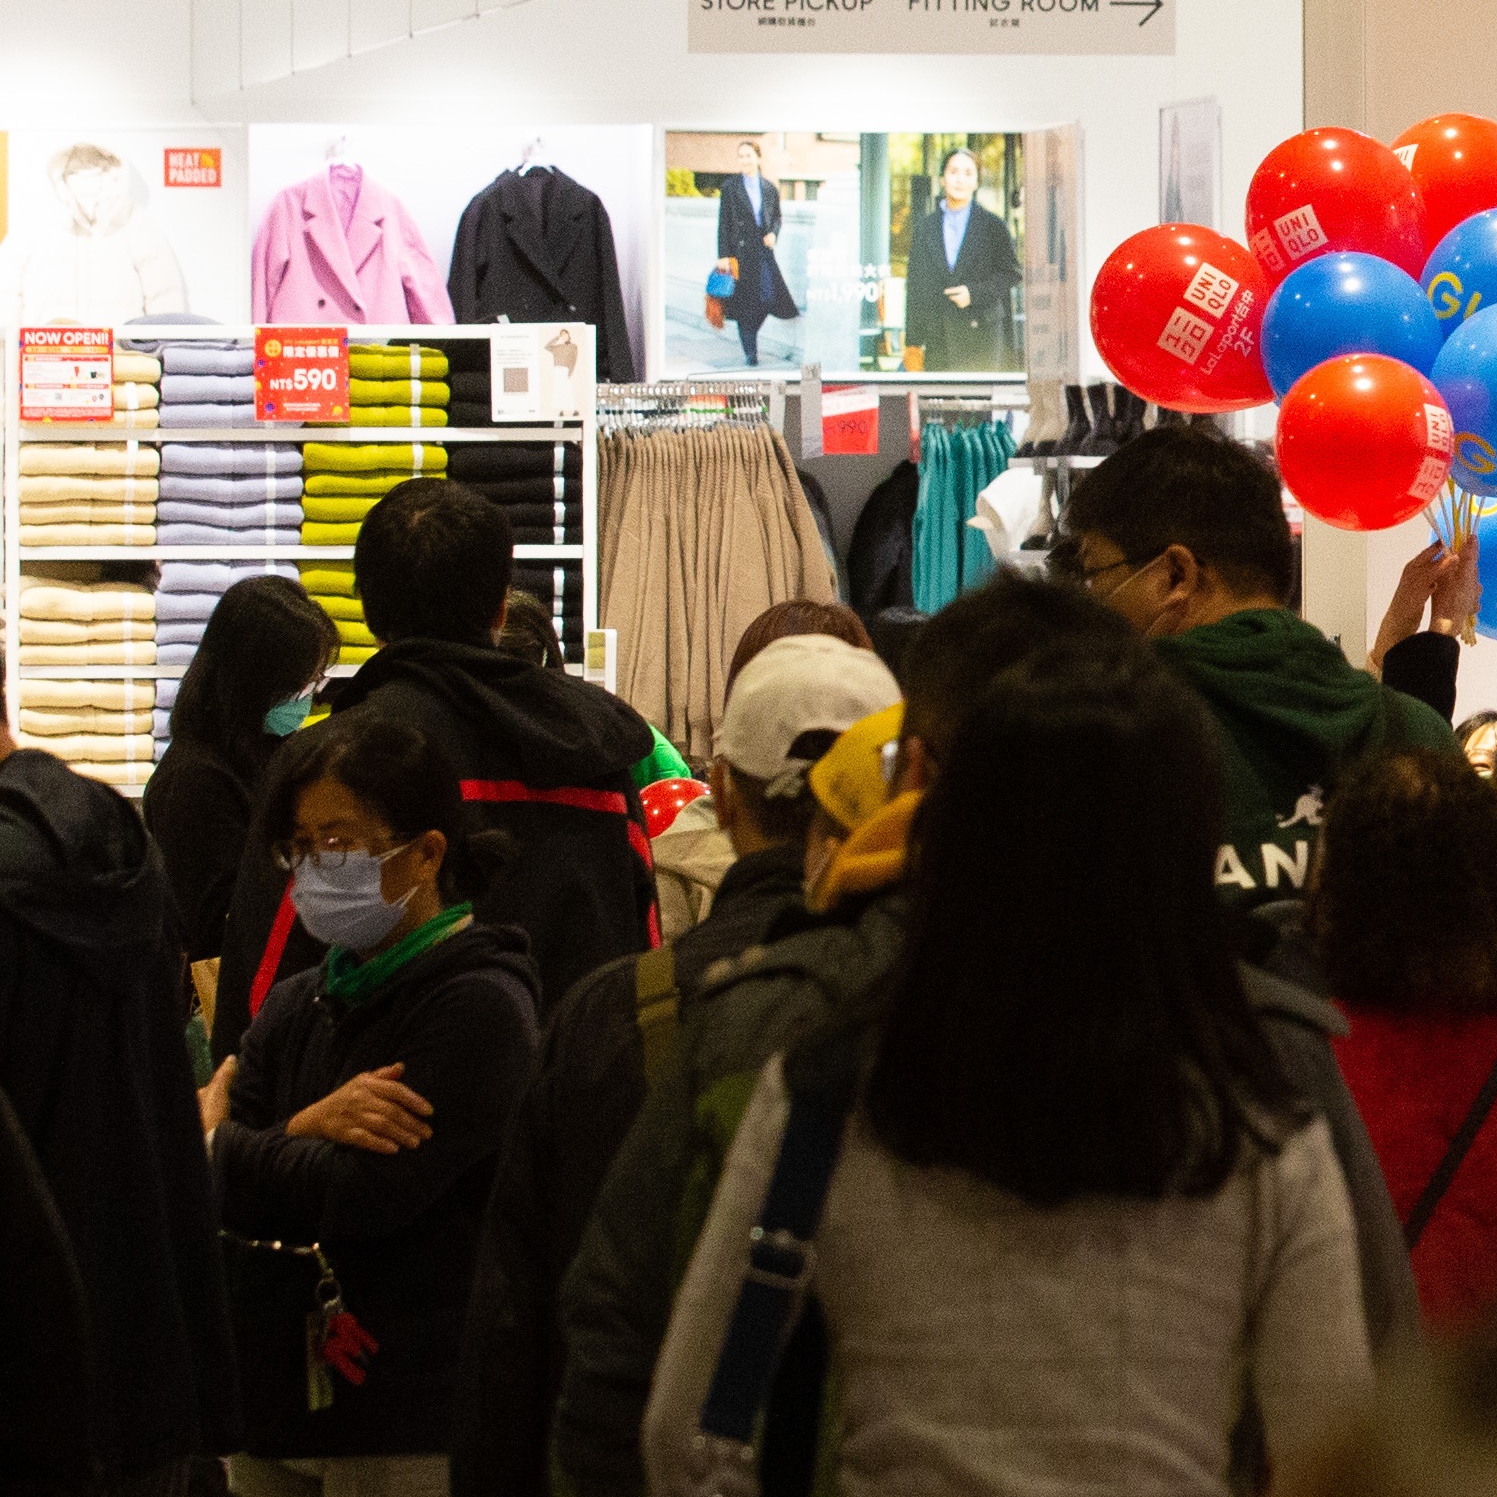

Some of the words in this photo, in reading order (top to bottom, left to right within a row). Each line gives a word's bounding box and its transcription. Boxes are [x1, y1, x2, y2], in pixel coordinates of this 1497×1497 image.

[169, 168, 217, 184] PADDED
[1278, 212, 1310, 236] UNI
[1287, 228, 1319, 254] QLO
[1190, 270, 1218, 302] UNI
[1206, 278, 1232, 310] QLO
[24, 332, 61, 345] NOW
[63, 332, 109, 345] OPEN!!
[1232, 326, 1255, 358] 2F
[270, 368, 337, 391] NT$590
[1430, 413, 1441, 443] UNI
[1214, 839, 1309, 890] AN
